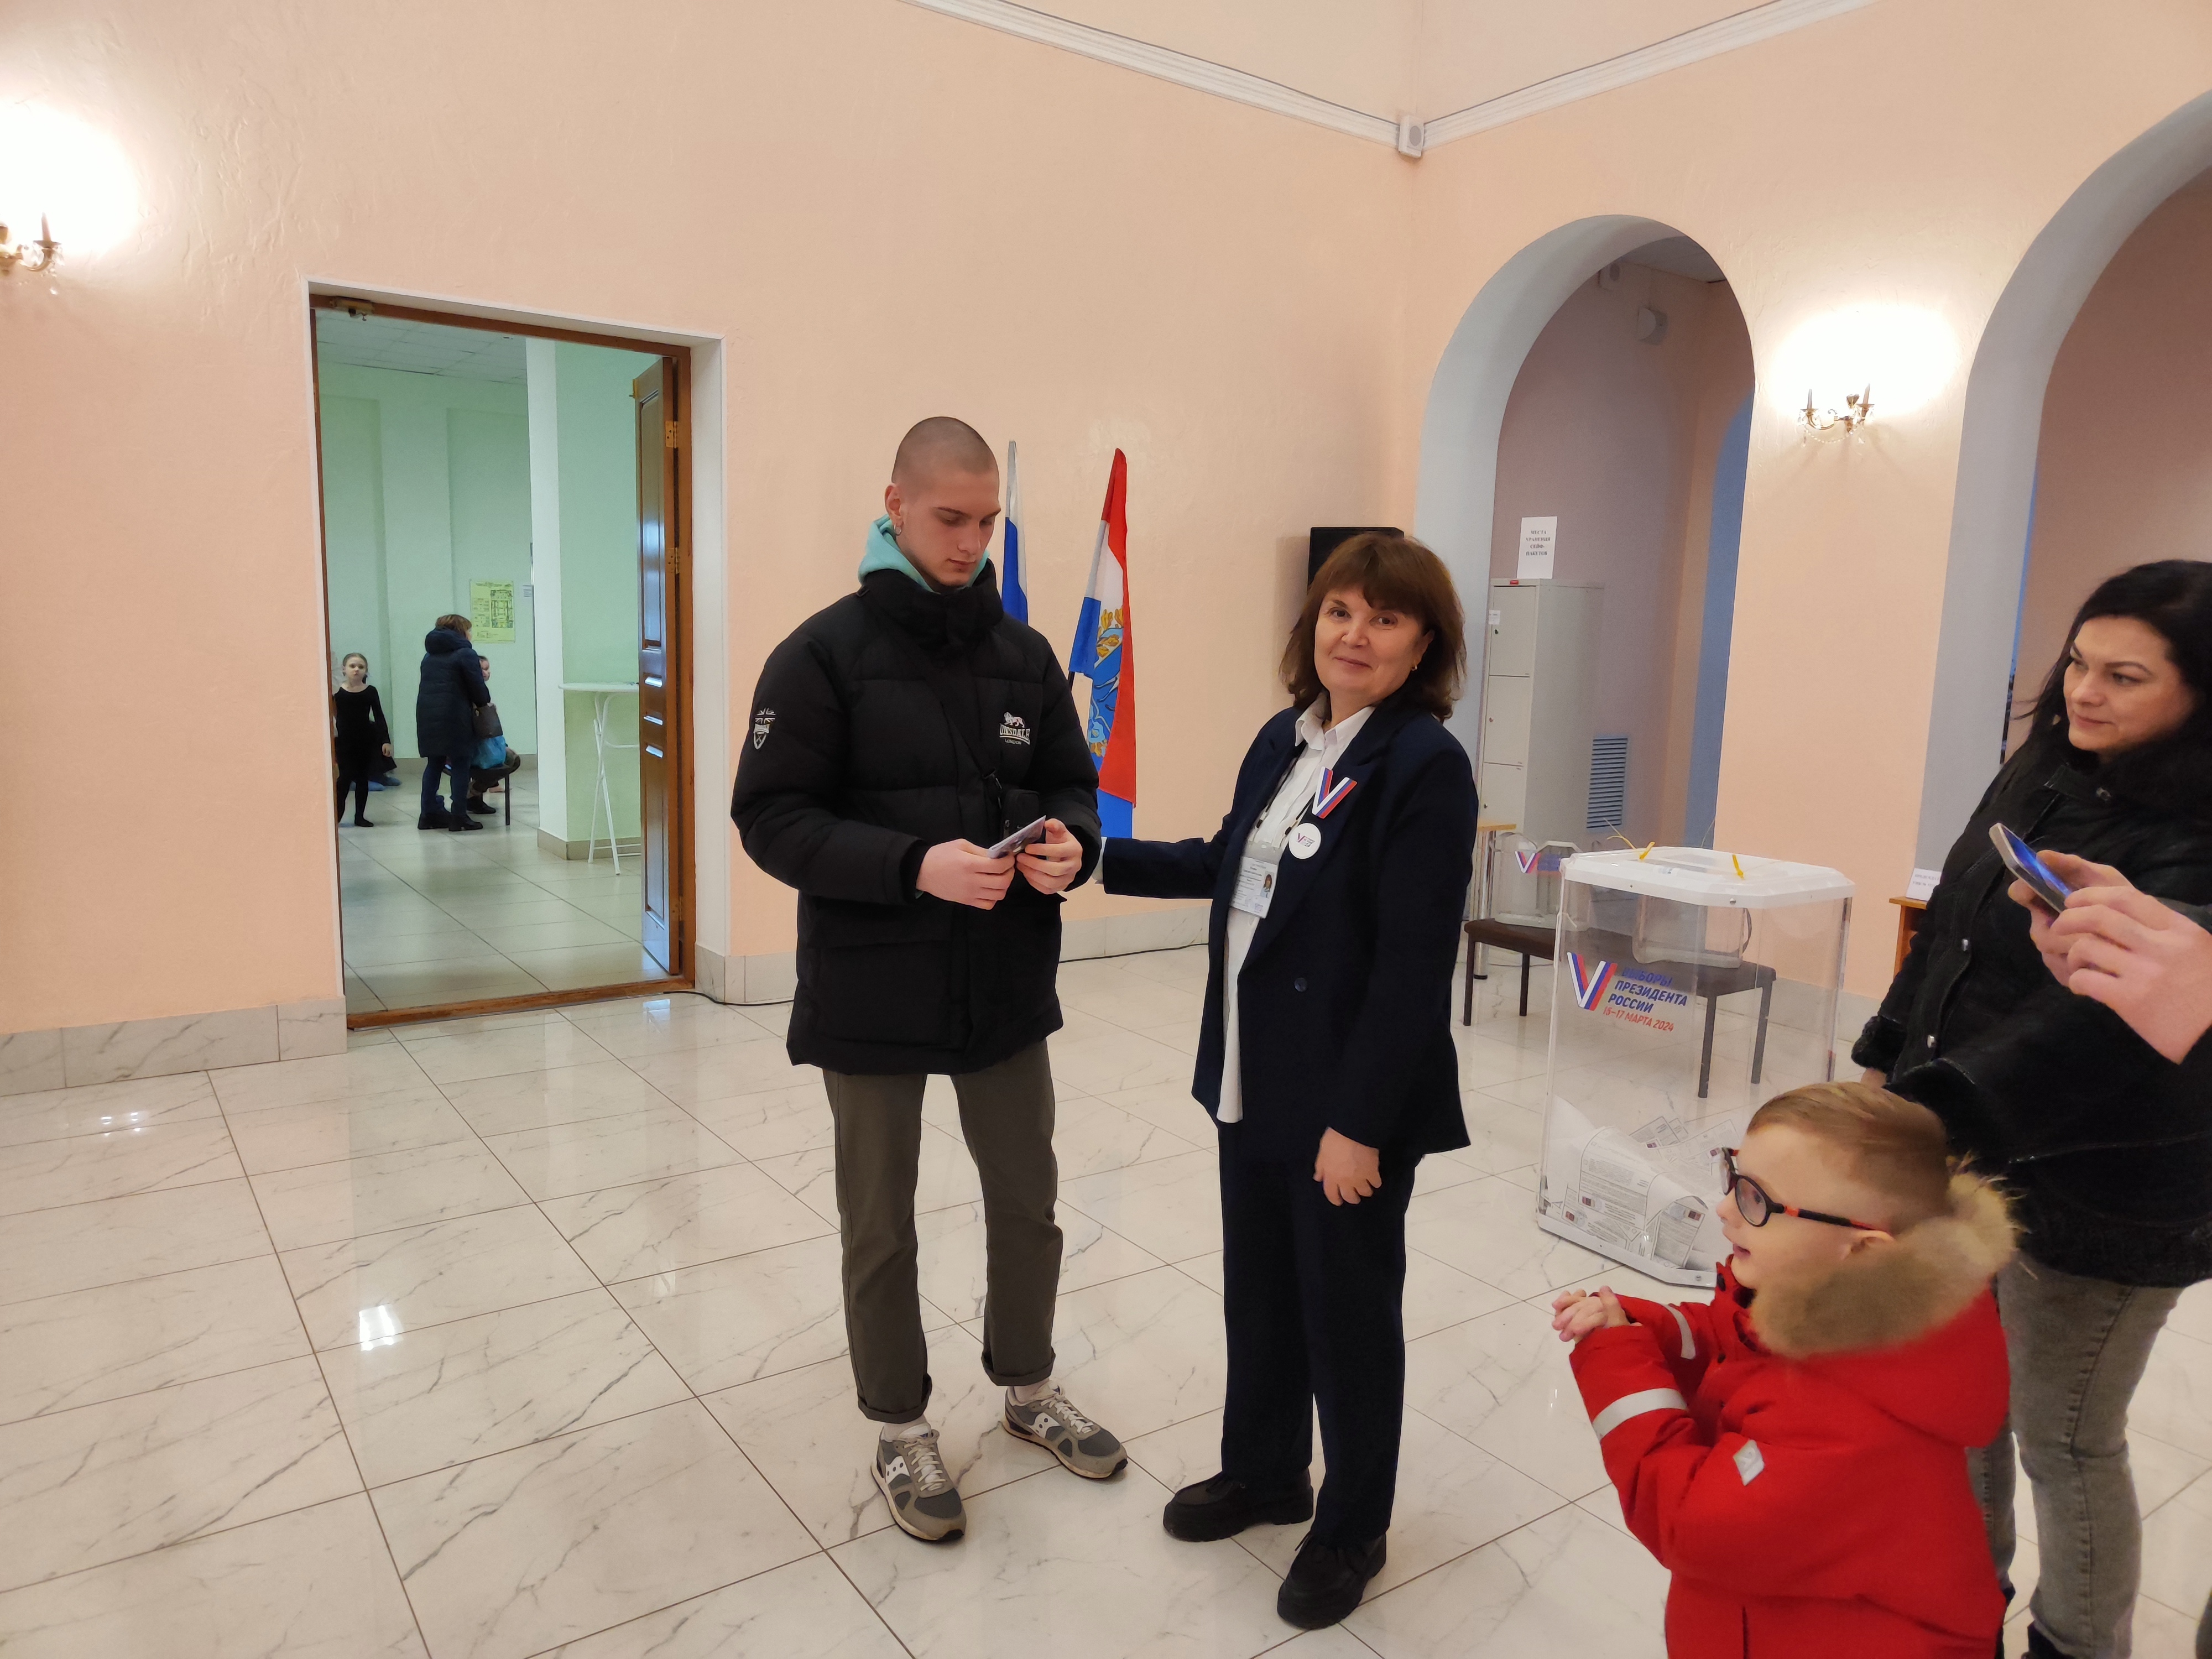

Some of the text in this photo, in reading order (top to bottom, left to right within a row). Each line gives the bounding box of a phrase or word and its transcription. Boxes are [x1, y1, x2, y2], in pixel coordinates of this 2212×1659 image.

[1621, 967, 1673, 987] ВЫБОРЫ
[1608, 993, 1655, 1013] РОССИИ
[1614, 980, 1688, 1006] ПРЕЗИДЕНТА
[1624, 1011, 1653, 1027] МАРТА
[1652, 1019, 1674, 1032] 2024
